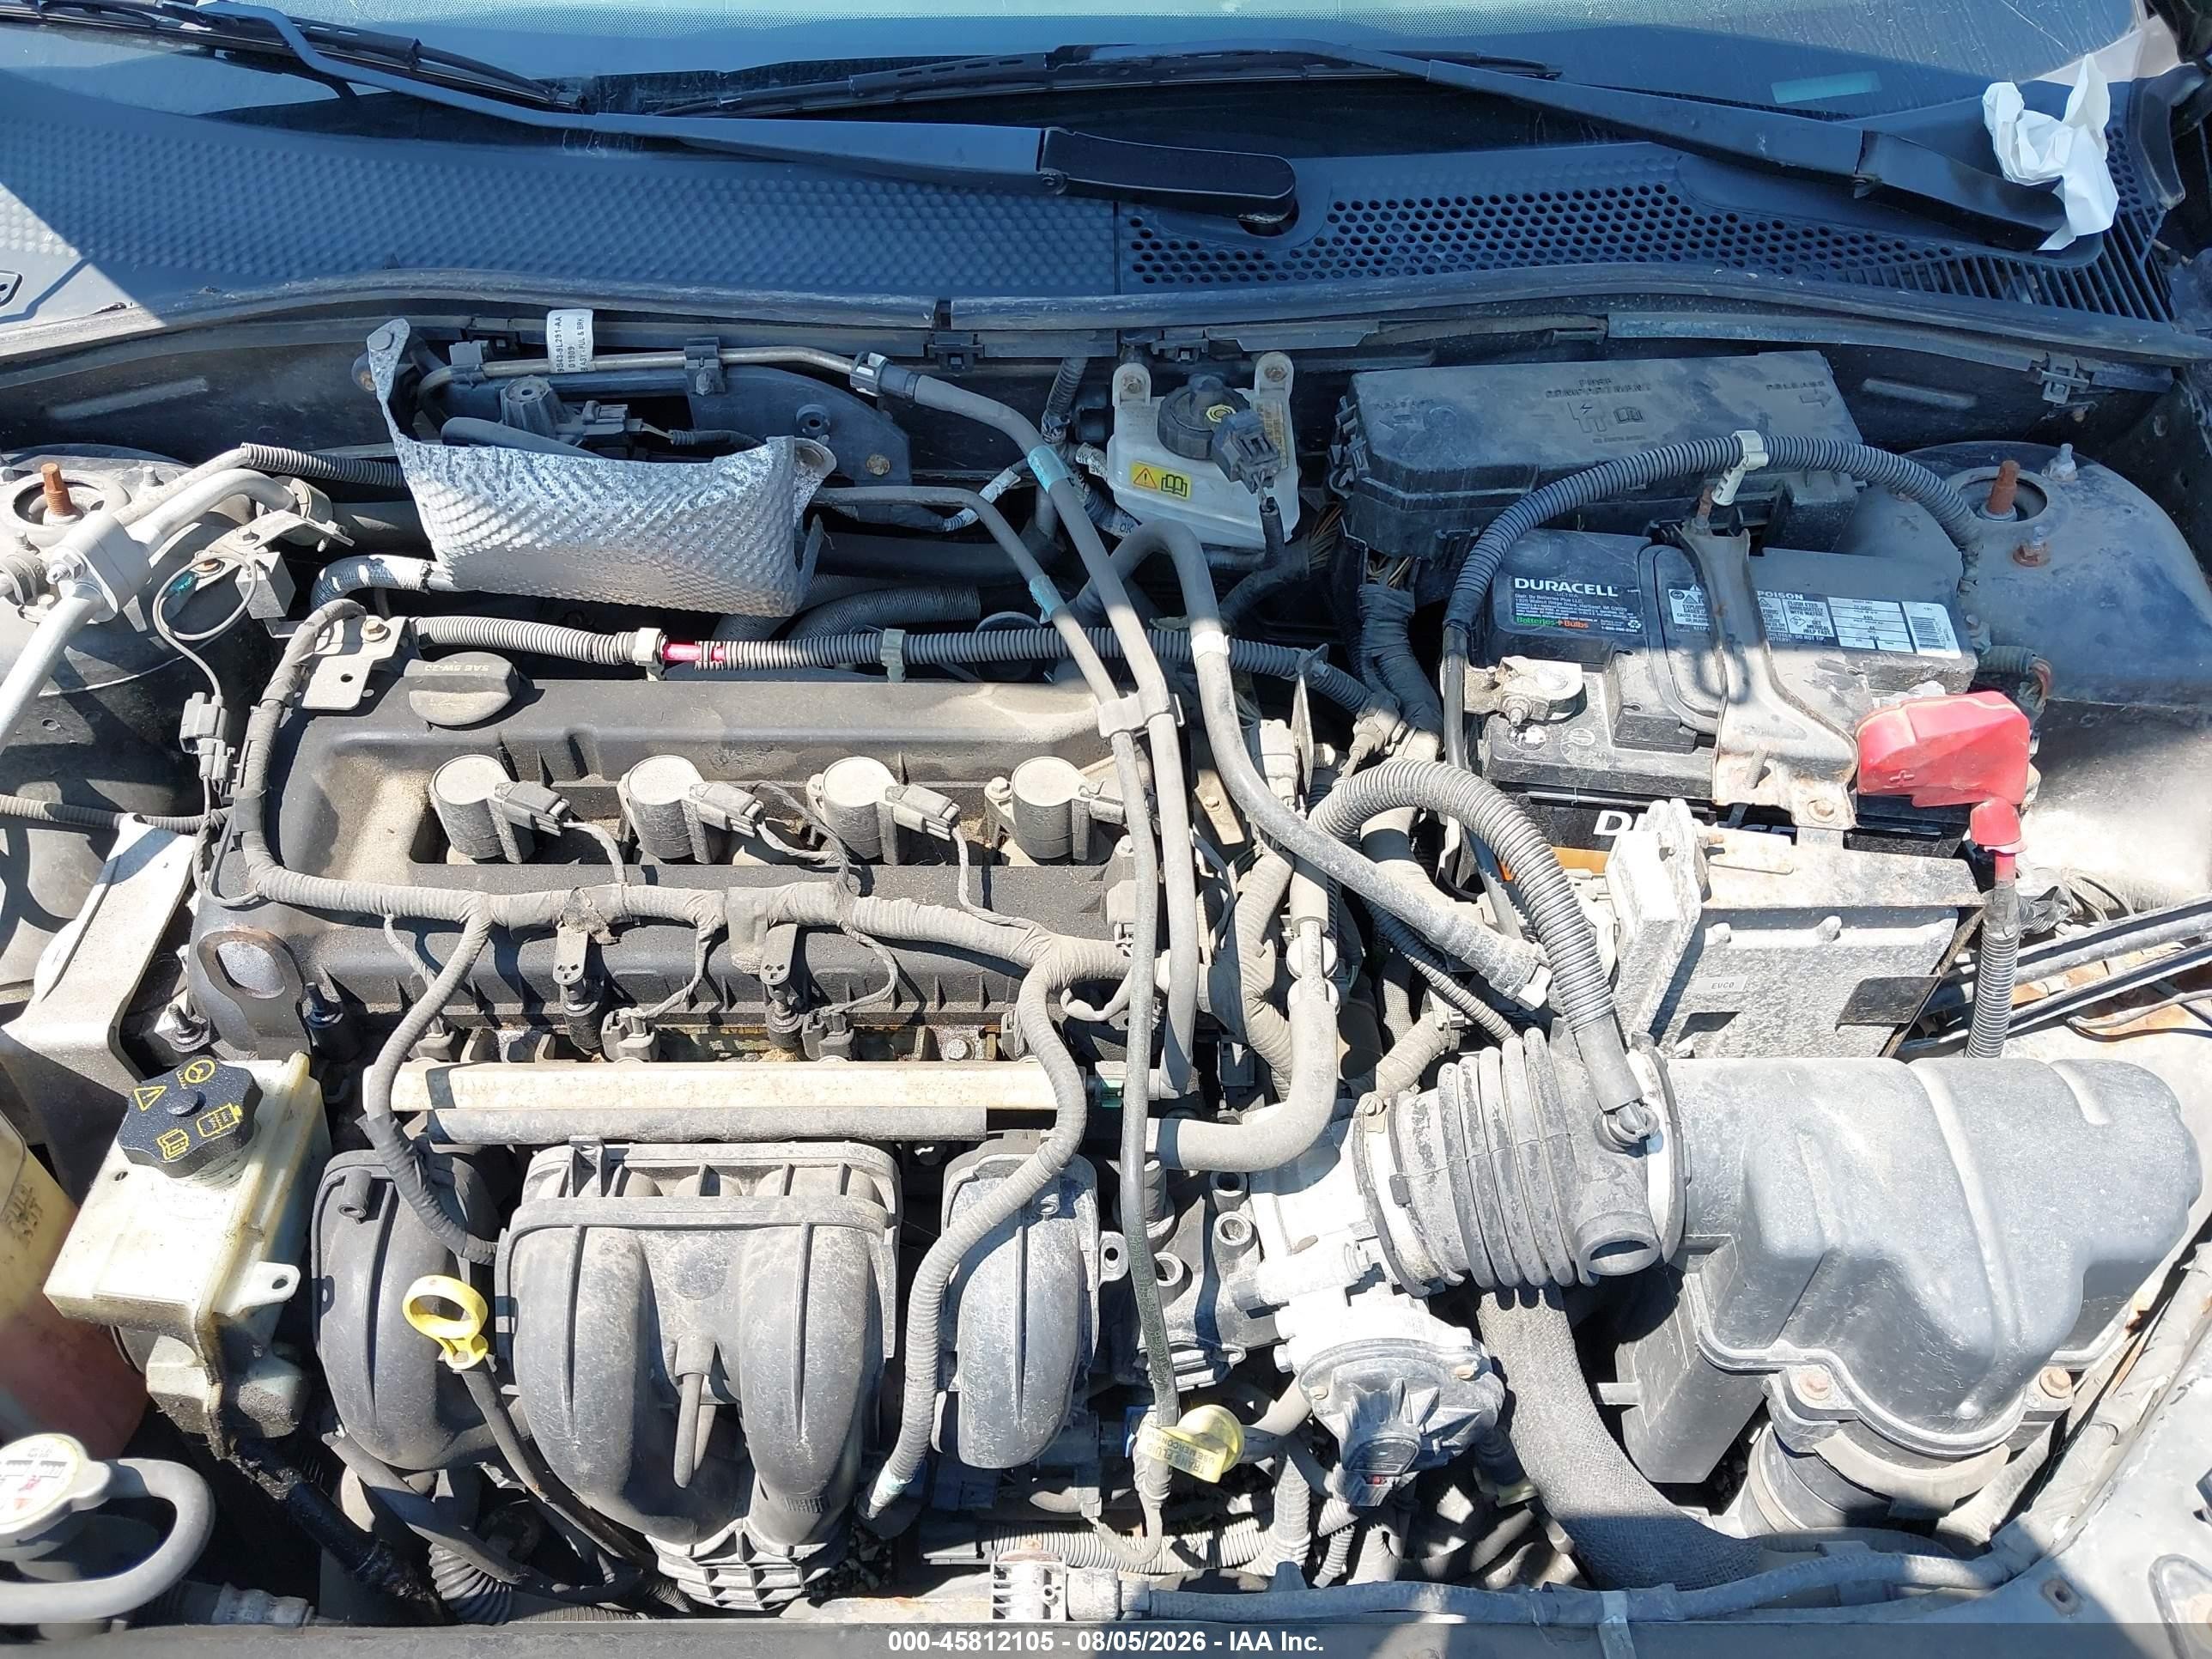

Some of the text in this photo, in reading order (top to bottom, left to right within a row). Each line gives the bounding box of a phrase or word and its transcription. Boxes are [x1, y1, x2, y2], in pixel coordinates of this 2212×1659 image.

[567, 346, 576, 368] 01909
[1514, 577, 1619, 598] DURACELL
[1756, 590, 1804, 600] POISON
